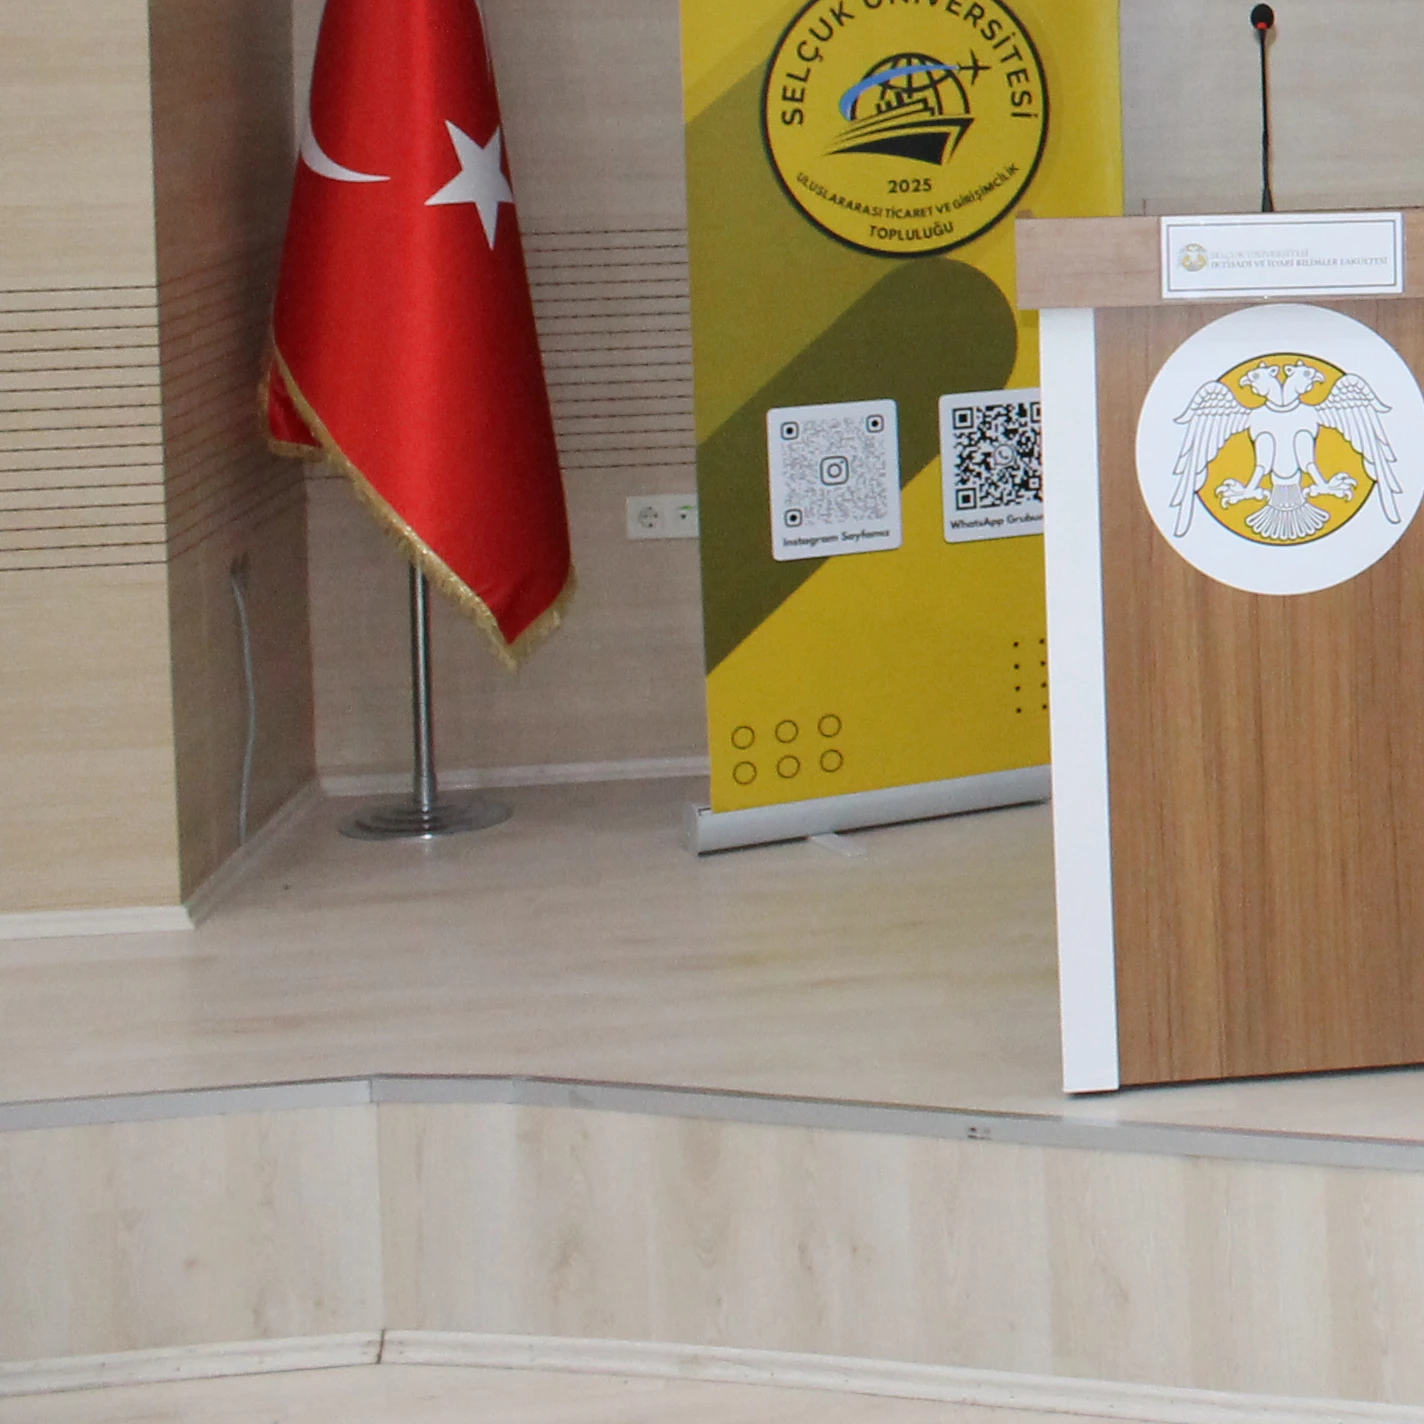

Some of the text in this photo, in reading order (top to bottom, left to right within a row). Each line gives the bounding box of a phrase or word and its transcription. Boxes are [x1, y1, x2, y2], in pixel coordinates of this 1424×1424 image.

[781, 0, 855, 126] SELÇUK
[887, 178, 932, 194] 2025
[796, 172, 882, 217] ULUSLARARASI
[885, 206, 933, 219] TİCARET
[935, 202, 950, 215] VE
[869, 221, 954, 241] TOPLULUĞU
[950, 516, 1004, 530] WhatsApp
[782, 533, 839, 548] Instagram
